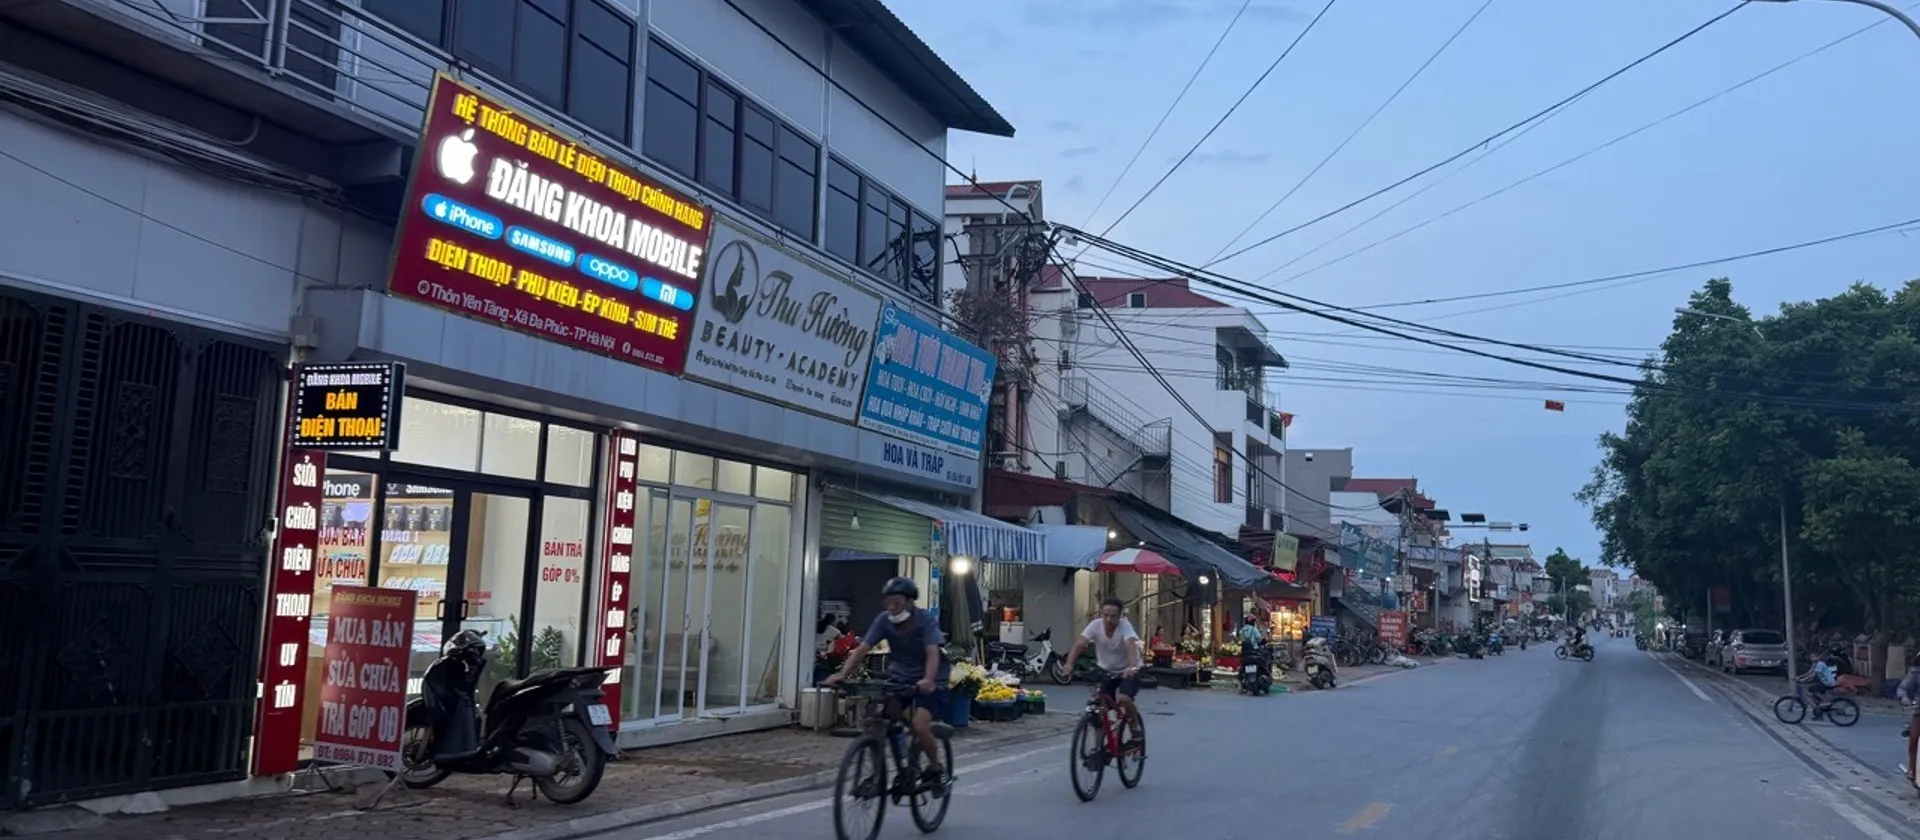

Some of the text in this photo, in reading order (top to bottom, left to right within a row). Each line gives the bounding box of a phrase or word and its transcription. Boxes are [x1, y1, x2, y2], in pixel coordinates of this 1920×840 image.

[452, 93, 478, 125] HỆ
[478, 103, 528, 146] THỐNG
[527, 129, 558, 160] BÁN
[576, 153, 606, 183] ĐIỆN
[607, 168, 641, 201] THOẠI
[641, 186, 674, 217] CHÍNH
[449, 204, 494, 235] iPhone
[485, 157, 702, 279] ĐĂNG KHOA MOBILE
[512, 230, 571, 262] SAMSUNG
[425, 238, 679, 340] ĐIỆN THOẠI PHỤ KIỆN ÉP KÍNH SIM THẺ
[431, 283, 460, 305] Thôn
[462, 292, 481, 311] Yên
[513, 308, 528, 324] Xã
[529, 313, 543, 329] Đa
[544, 318, 569, 336] Phúc
[574, 326, 587, 341] TP
[758, 270, 868, 369] Thu Hường
[700, 320, 775, 362] BEAUTY
[785, 351, 859, 391] ACADEMY
[329, 373, 350, 386] KHOA
[351, 373, 382, 385] MOBILE
[325, 388, 358, 410] BÁN
[300, 414, 381, 441] ĐIỆN THOẠI
[883, 442, 904, 465] HOA
[544, 537, 583, 558] BÁN TRẢ
[275, 455, 317, 708] SỬA CHỮA ĐIỆN THOẠI UY TÍN
[542, 564, 580, 583] GÓP 0%
[611, 581, 623, 602] ÉP
[333, 613, 406, 648] MUA BÁN
[327, 650, 356, 688] SỬA
[361, 657, 401, 693] CHỮA
[321, 695, 345, 737] TRẢ
[348, 699, 377, 740] GÓP
